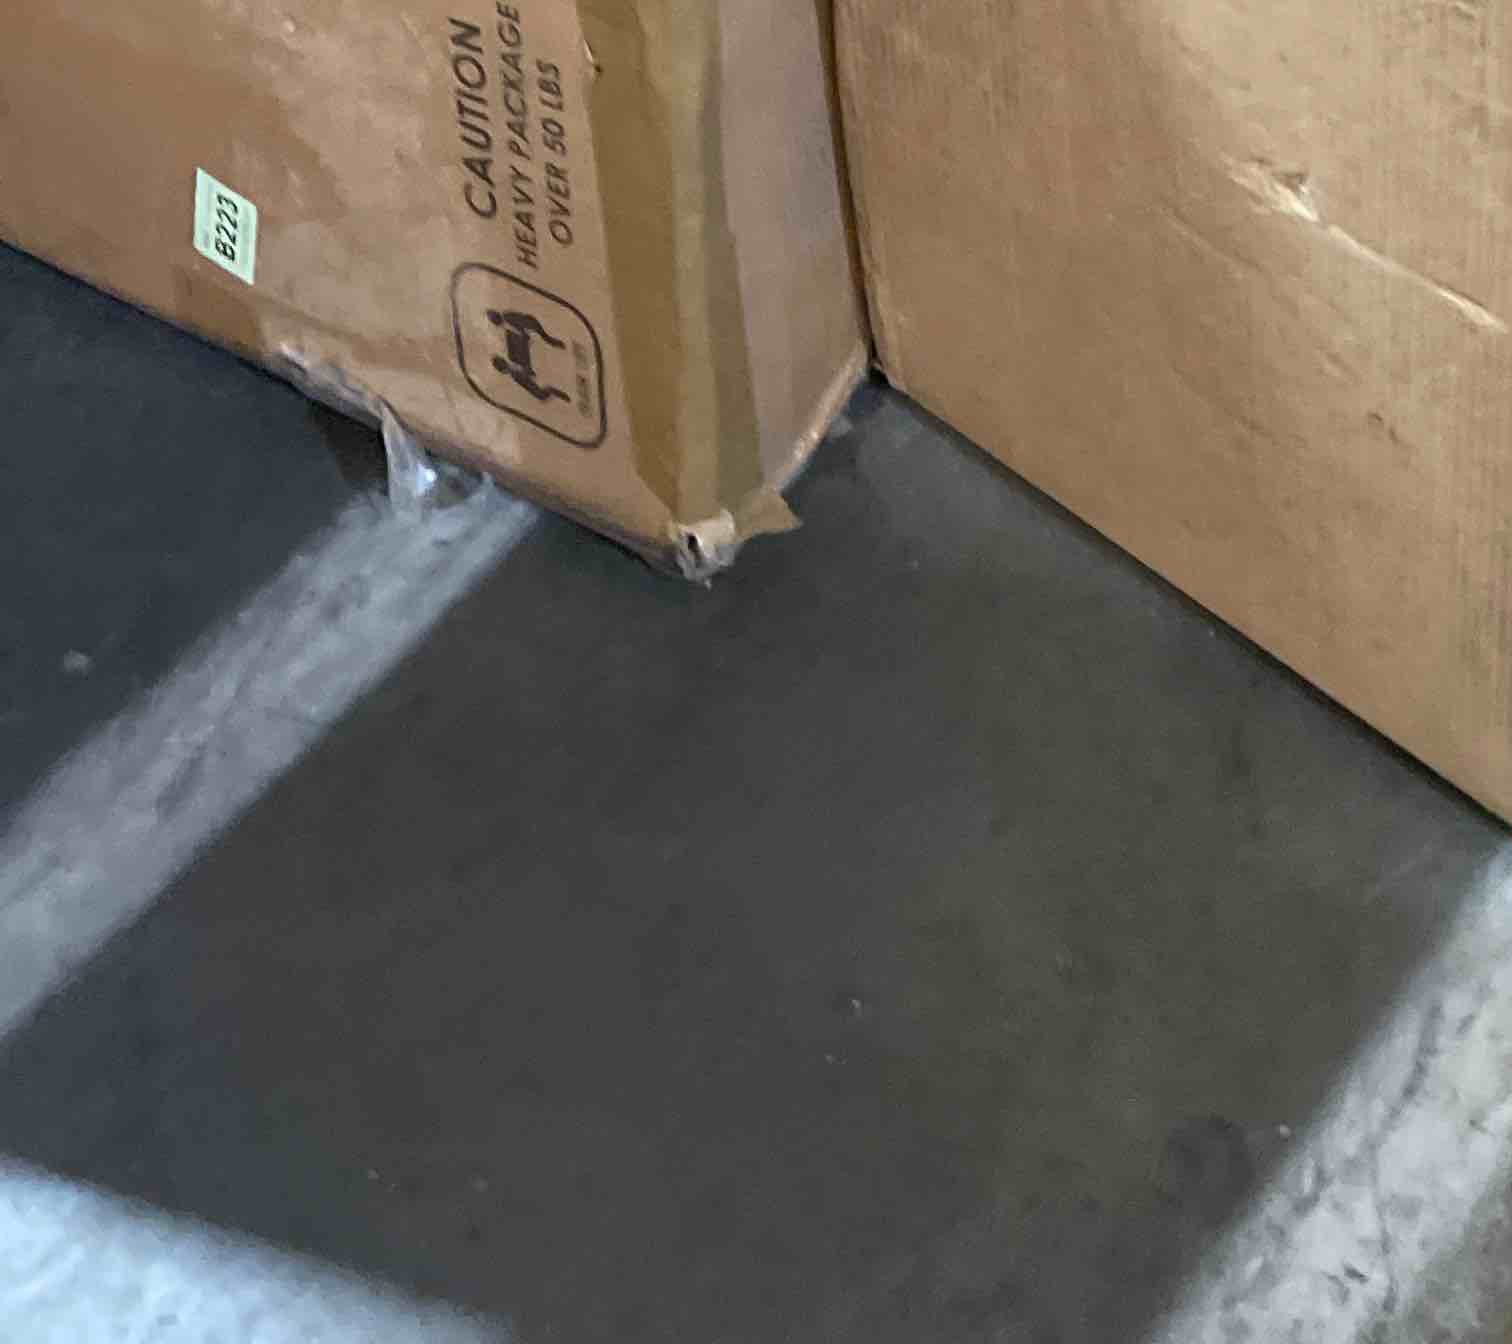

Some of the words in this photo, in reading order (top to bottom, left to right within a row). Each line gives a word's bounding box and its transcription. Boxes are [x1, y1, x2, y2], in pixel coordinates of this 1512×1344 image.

[448, 16, 498, 220] CAUTION
[496, 0, 532, 161] PACKAGE
[536, 57, 564, 112] LBS
[541, 117, 567, 158] 50
[510, 164, 538, 271] HEAVY
[544, 162, 574, 247] OVER
